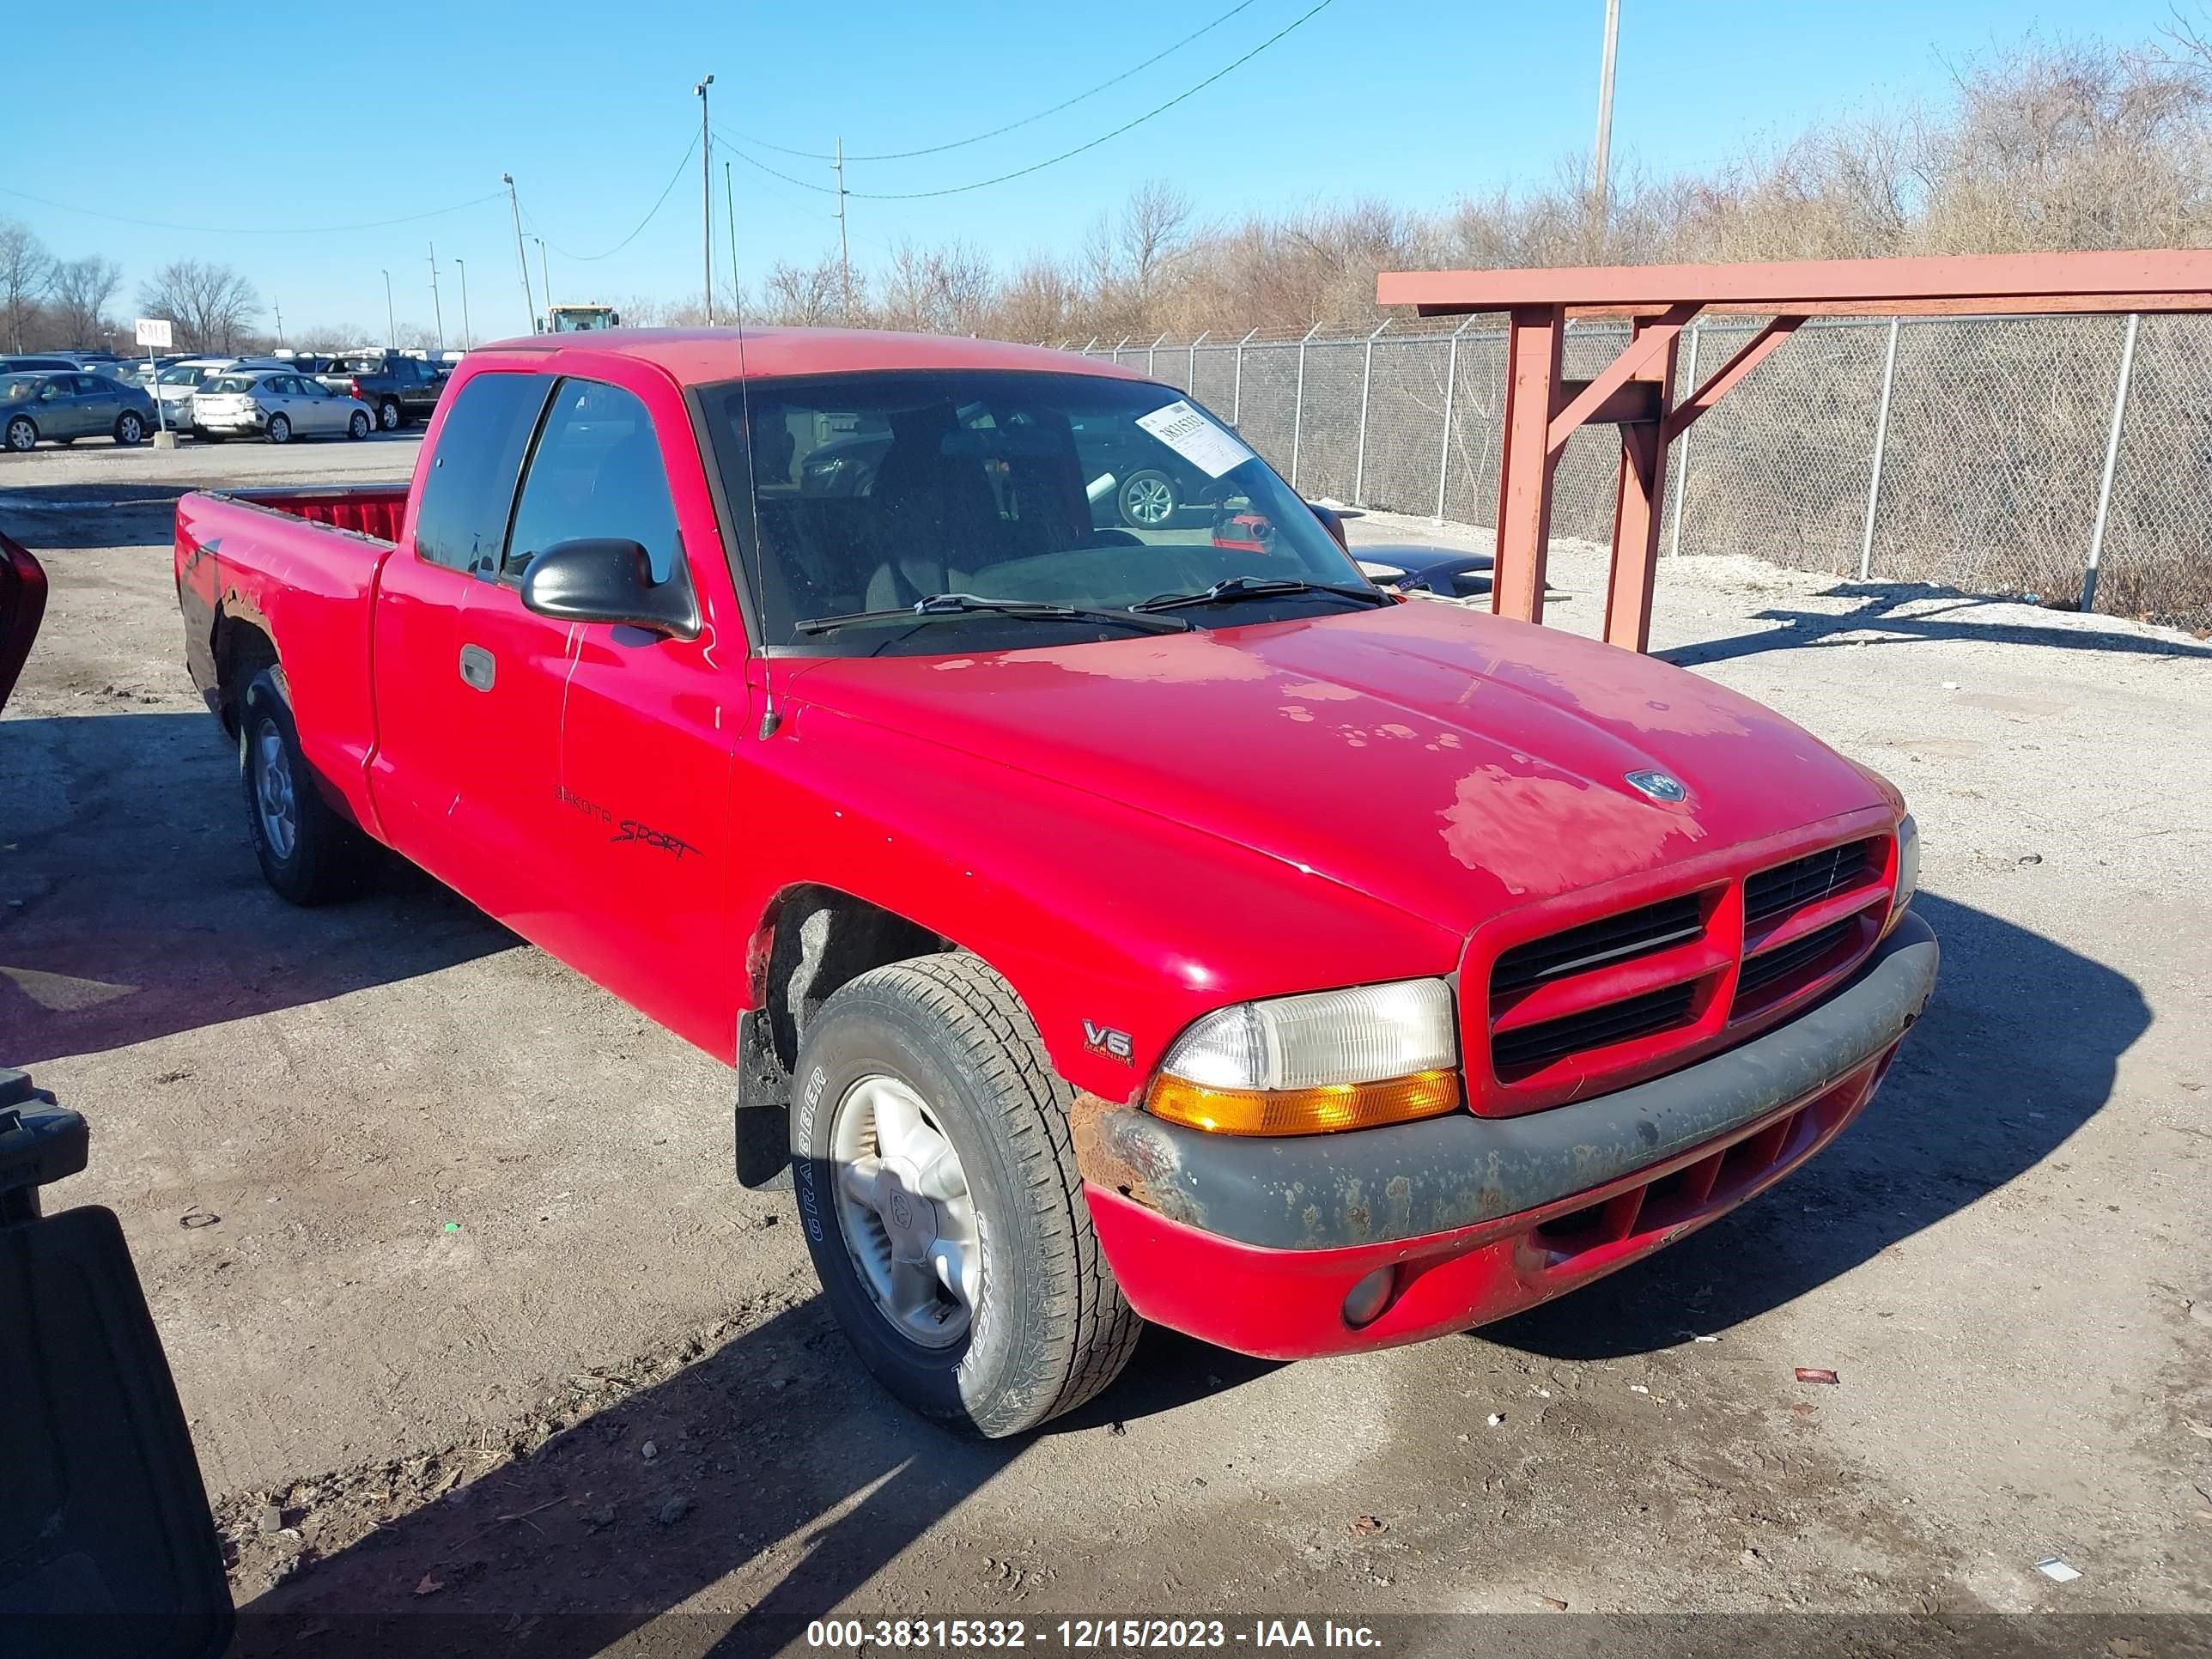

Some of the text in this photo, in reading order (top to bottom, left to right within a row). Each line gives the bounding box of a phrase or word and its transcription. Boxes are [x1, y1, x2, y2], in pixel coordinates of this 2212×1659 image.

[1158, 414, 1206, 441] 38315332
[553, 784, 708, 866] DAKOTA SPORT
[1082, 1018, 1133, 1058] V6
[1084, 1040, 1134, 1067] MAGNUM
[799, 1066, 828, 1242] GRABBER
[951, 1210, 994, 1384] GENERAL
